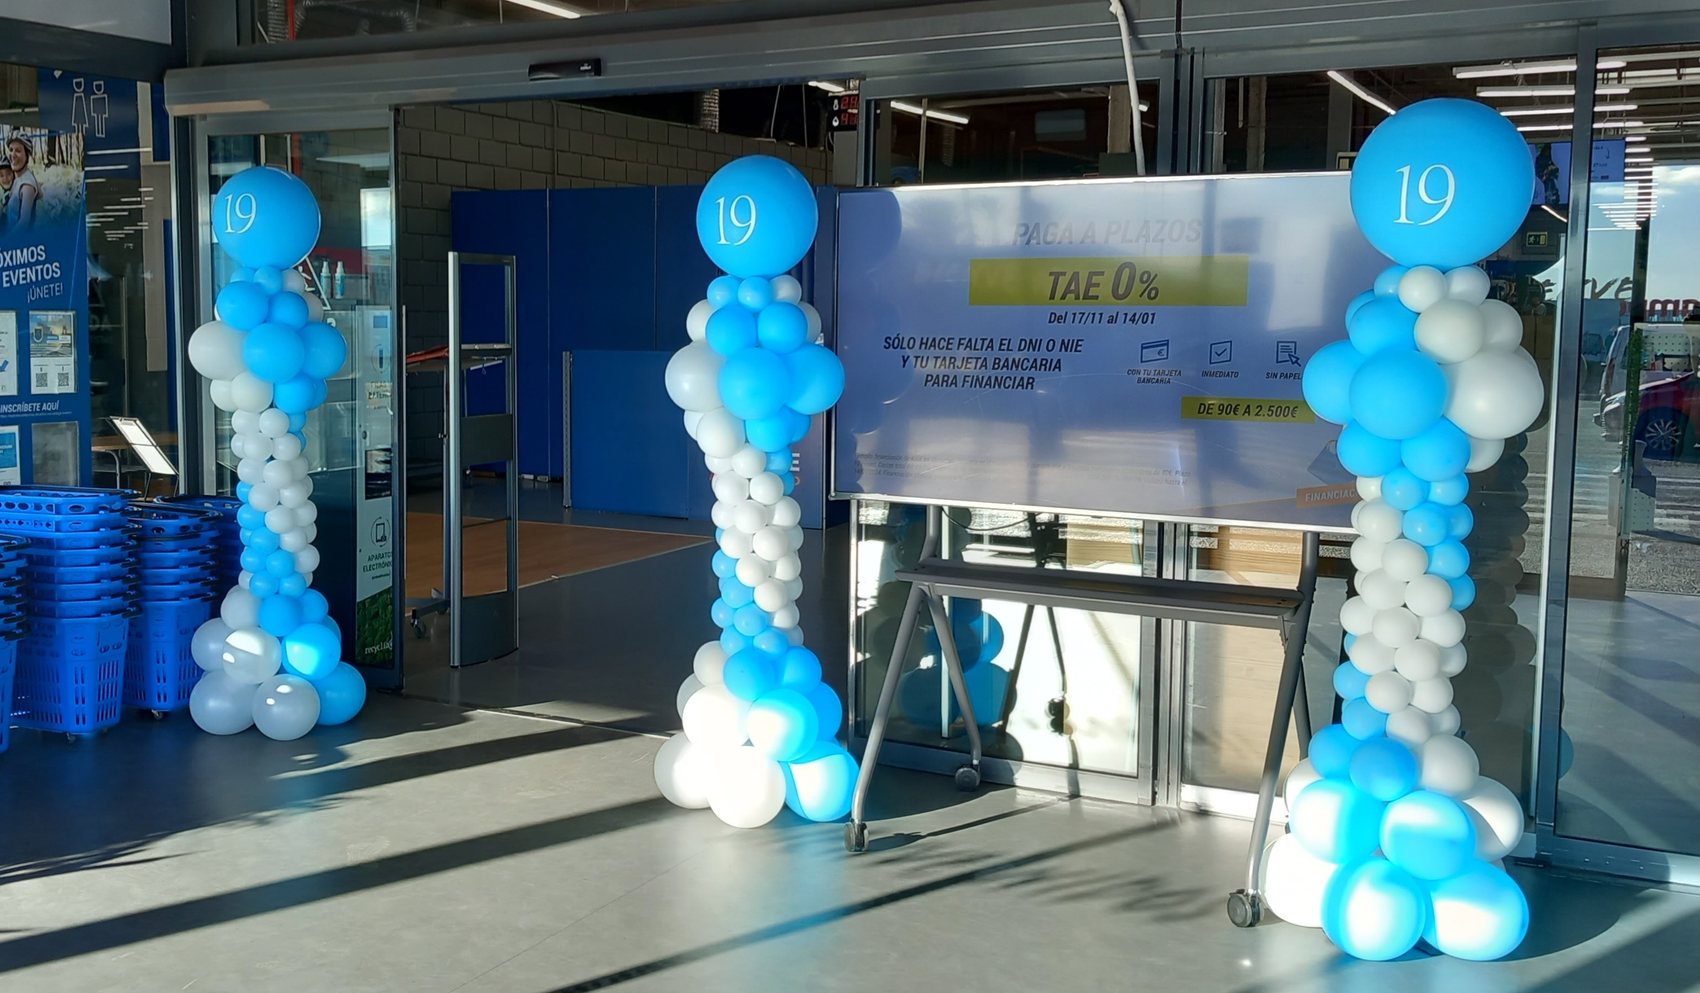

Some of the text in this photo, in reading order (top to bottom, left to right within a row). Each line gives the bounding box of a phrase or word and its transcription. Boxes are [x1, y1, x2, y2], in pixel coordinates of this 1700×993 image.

[1393, 163, 1456, 226] 19
[225, 193, 257, 234] 19
[715, 194, 757, 246] 19
[1013, 218, 1203, 246] PAGA A PLAZOS
[2, 262, 61, 288] EVENTOS
[1048, 261, 1160, 301] TAE 0%
[27, 282, 63, 304] ¡ÚNETE!
[1047, 311, 1157, 326] Del 17/11 al 14/01
[883, 333, 1085, 353] SÓLO HACE FALTA EL DNI O NIE
[901, 355, 1062, 372] Y TU TARJETA BANCARIA
[1126, 368, 1182, 377] CON TU TARJETA
[1136, 377, 1172, 385] BANCARIA
[1201, 370, 1240, 379] INMEDIATO
[1265, 372, 1278, 380] SIN
[923, 374, 1036, 390] PARA FINANCIAR
[0, 399, 60, 414] INSCRÍBETE AQUÍ
[1197, 402, 1299, 418] DE 90€ A 2.500€
